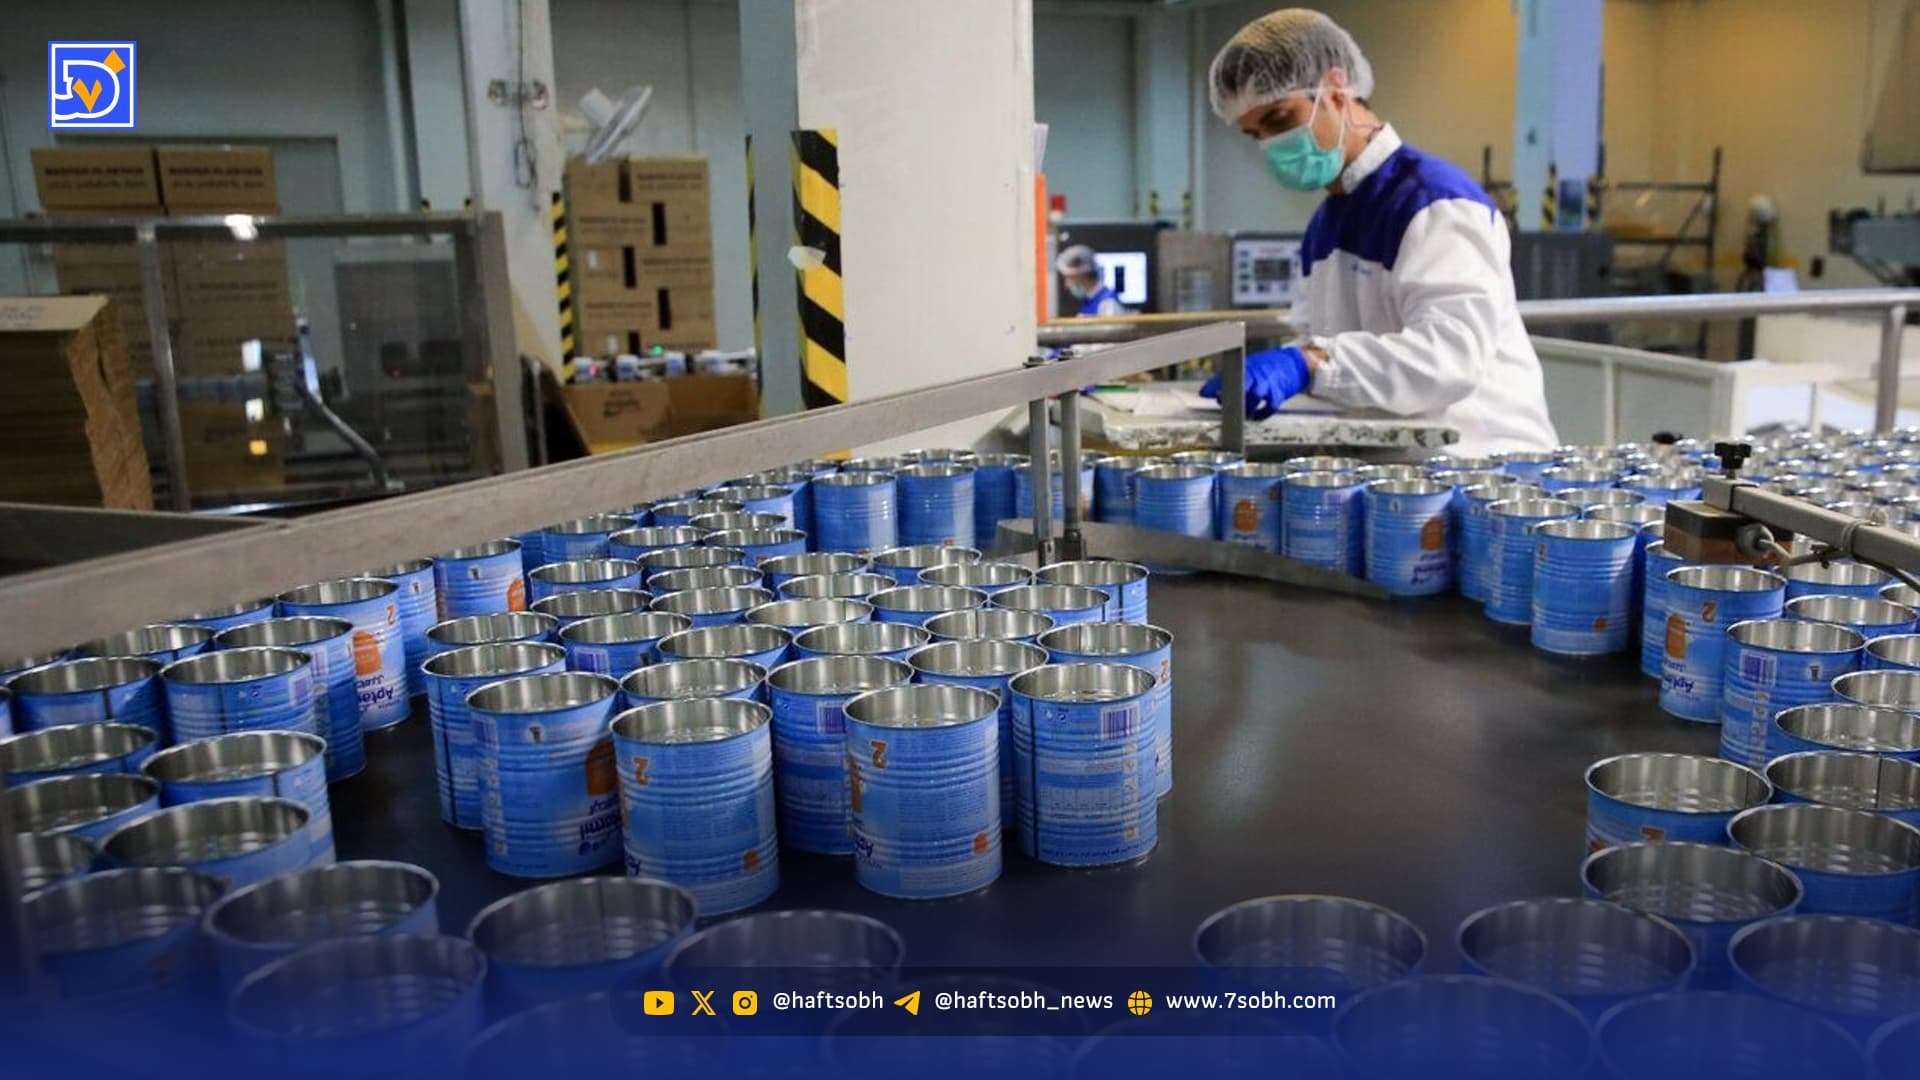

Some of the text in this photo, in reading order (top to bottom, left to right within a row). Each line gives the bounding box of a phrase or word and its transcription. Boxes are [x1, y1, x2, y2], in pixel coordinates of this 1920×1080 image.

[386, 605, 396, 626] 2
[1702, 602, 1717, 623] 2
[1160, 659, 1169, 685] 2
[357, 686, 394, 705] Apta
[871, 741, 888, 769] 2
[633, 757, 650, 786] 2
